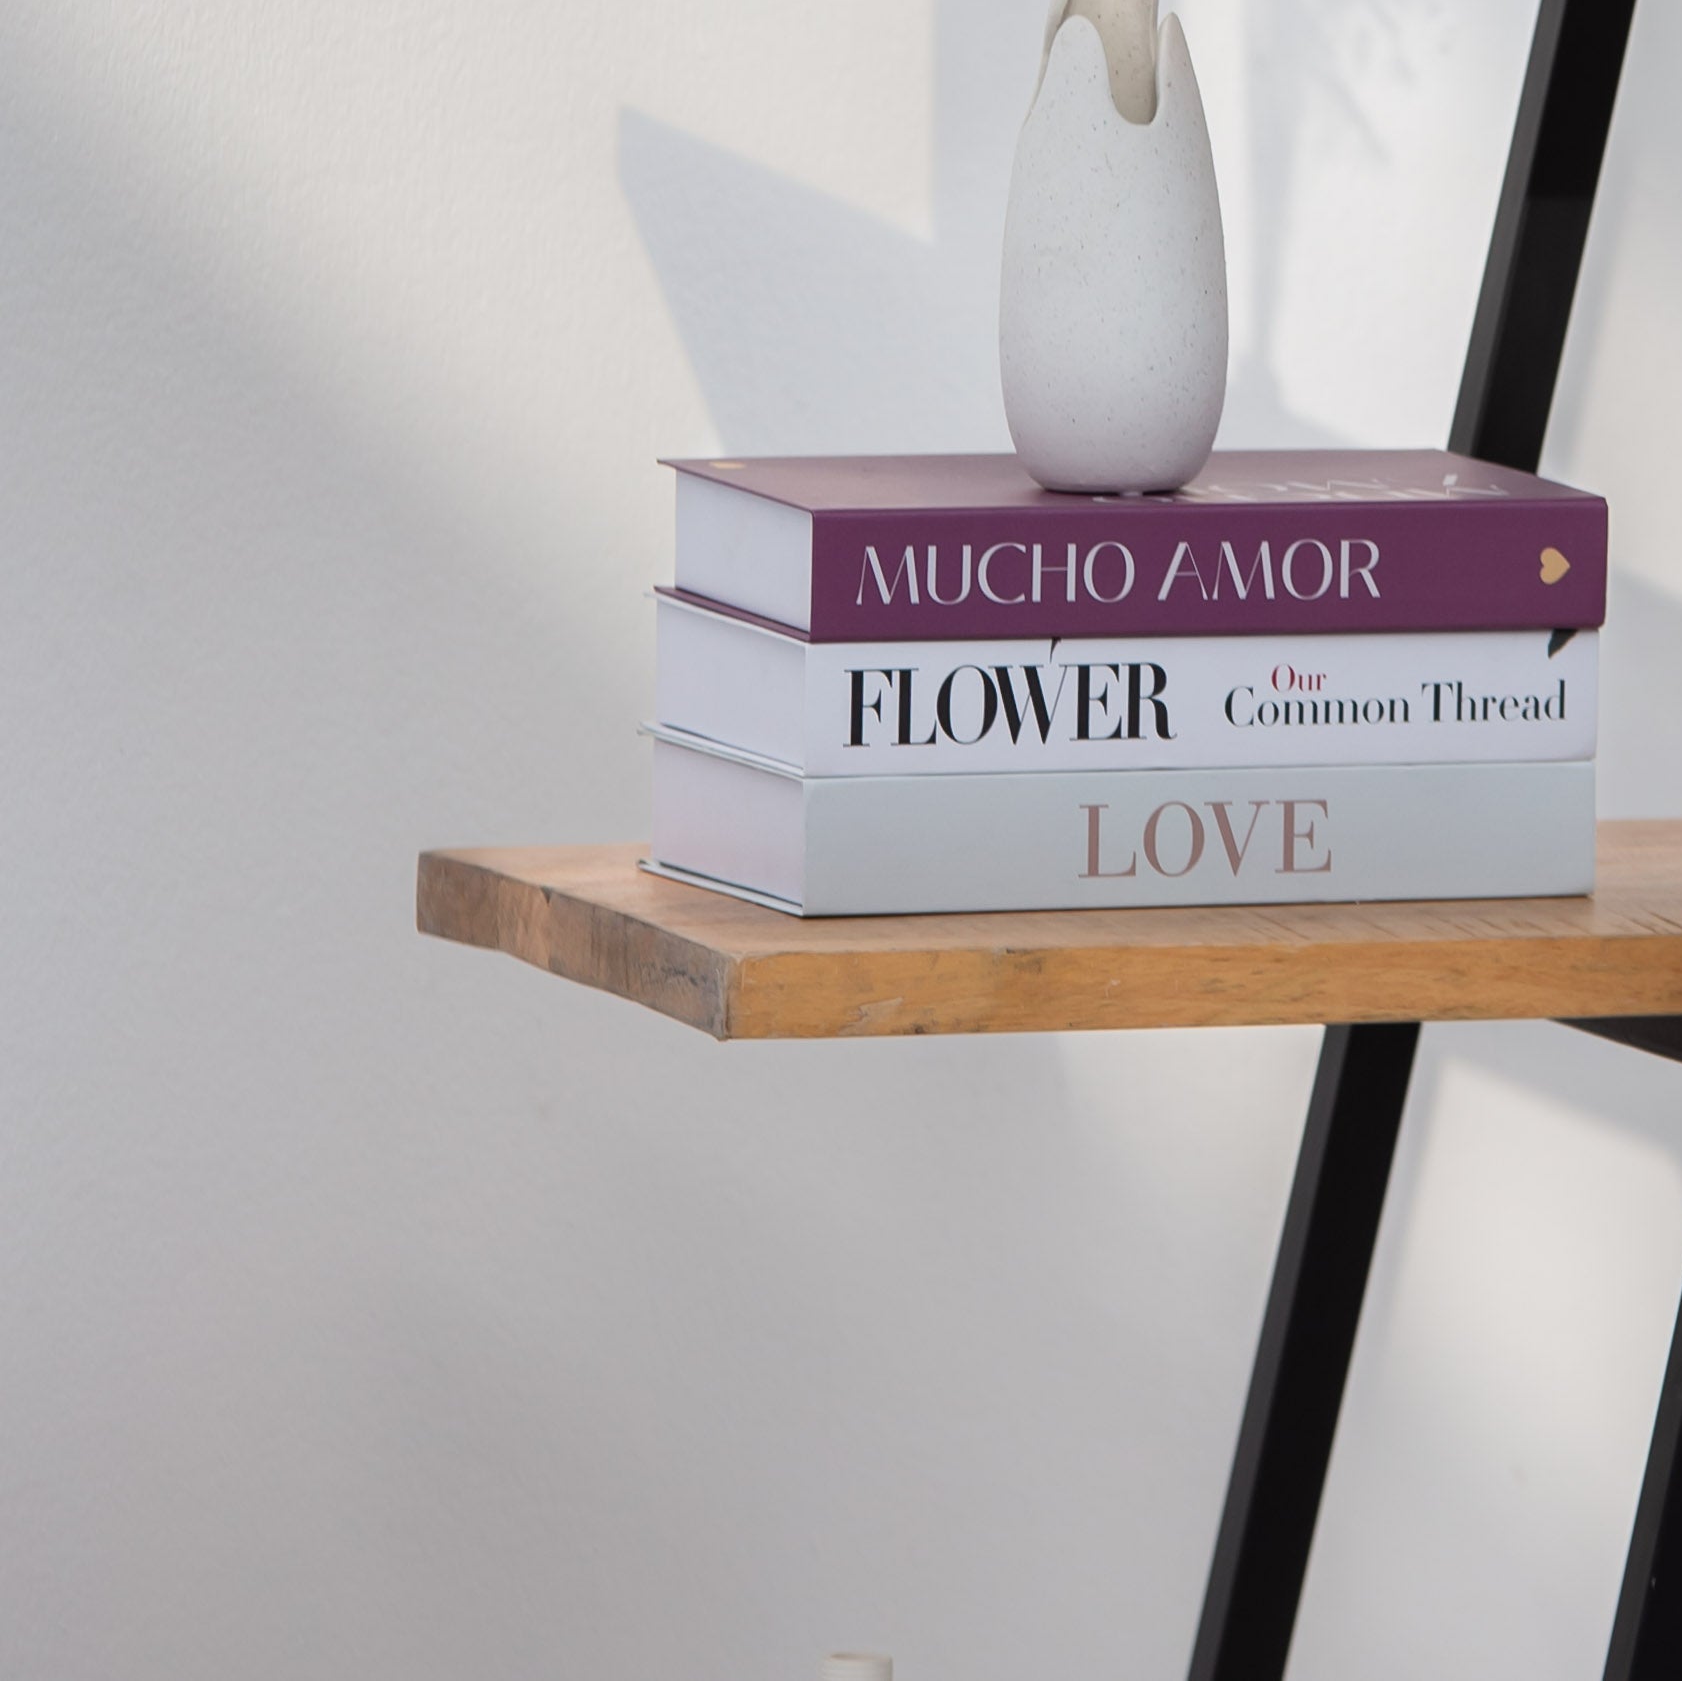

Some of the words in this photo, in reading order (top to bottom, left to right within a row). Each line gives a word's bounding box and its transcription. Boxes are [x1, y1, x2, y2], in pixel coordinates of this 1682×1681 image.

[856, 541, 1136, 606] MUCHO
[1157, 538, 1382, 601] AMOR
[842, 662, 1178, 748] FLOWER
[1224, 685, 1410, 728] Common
[1421, 679, 1566, 723] Thread
[1271, 663, 1327, 693] Our
[1078, 799, 1332, 878] LOVE
